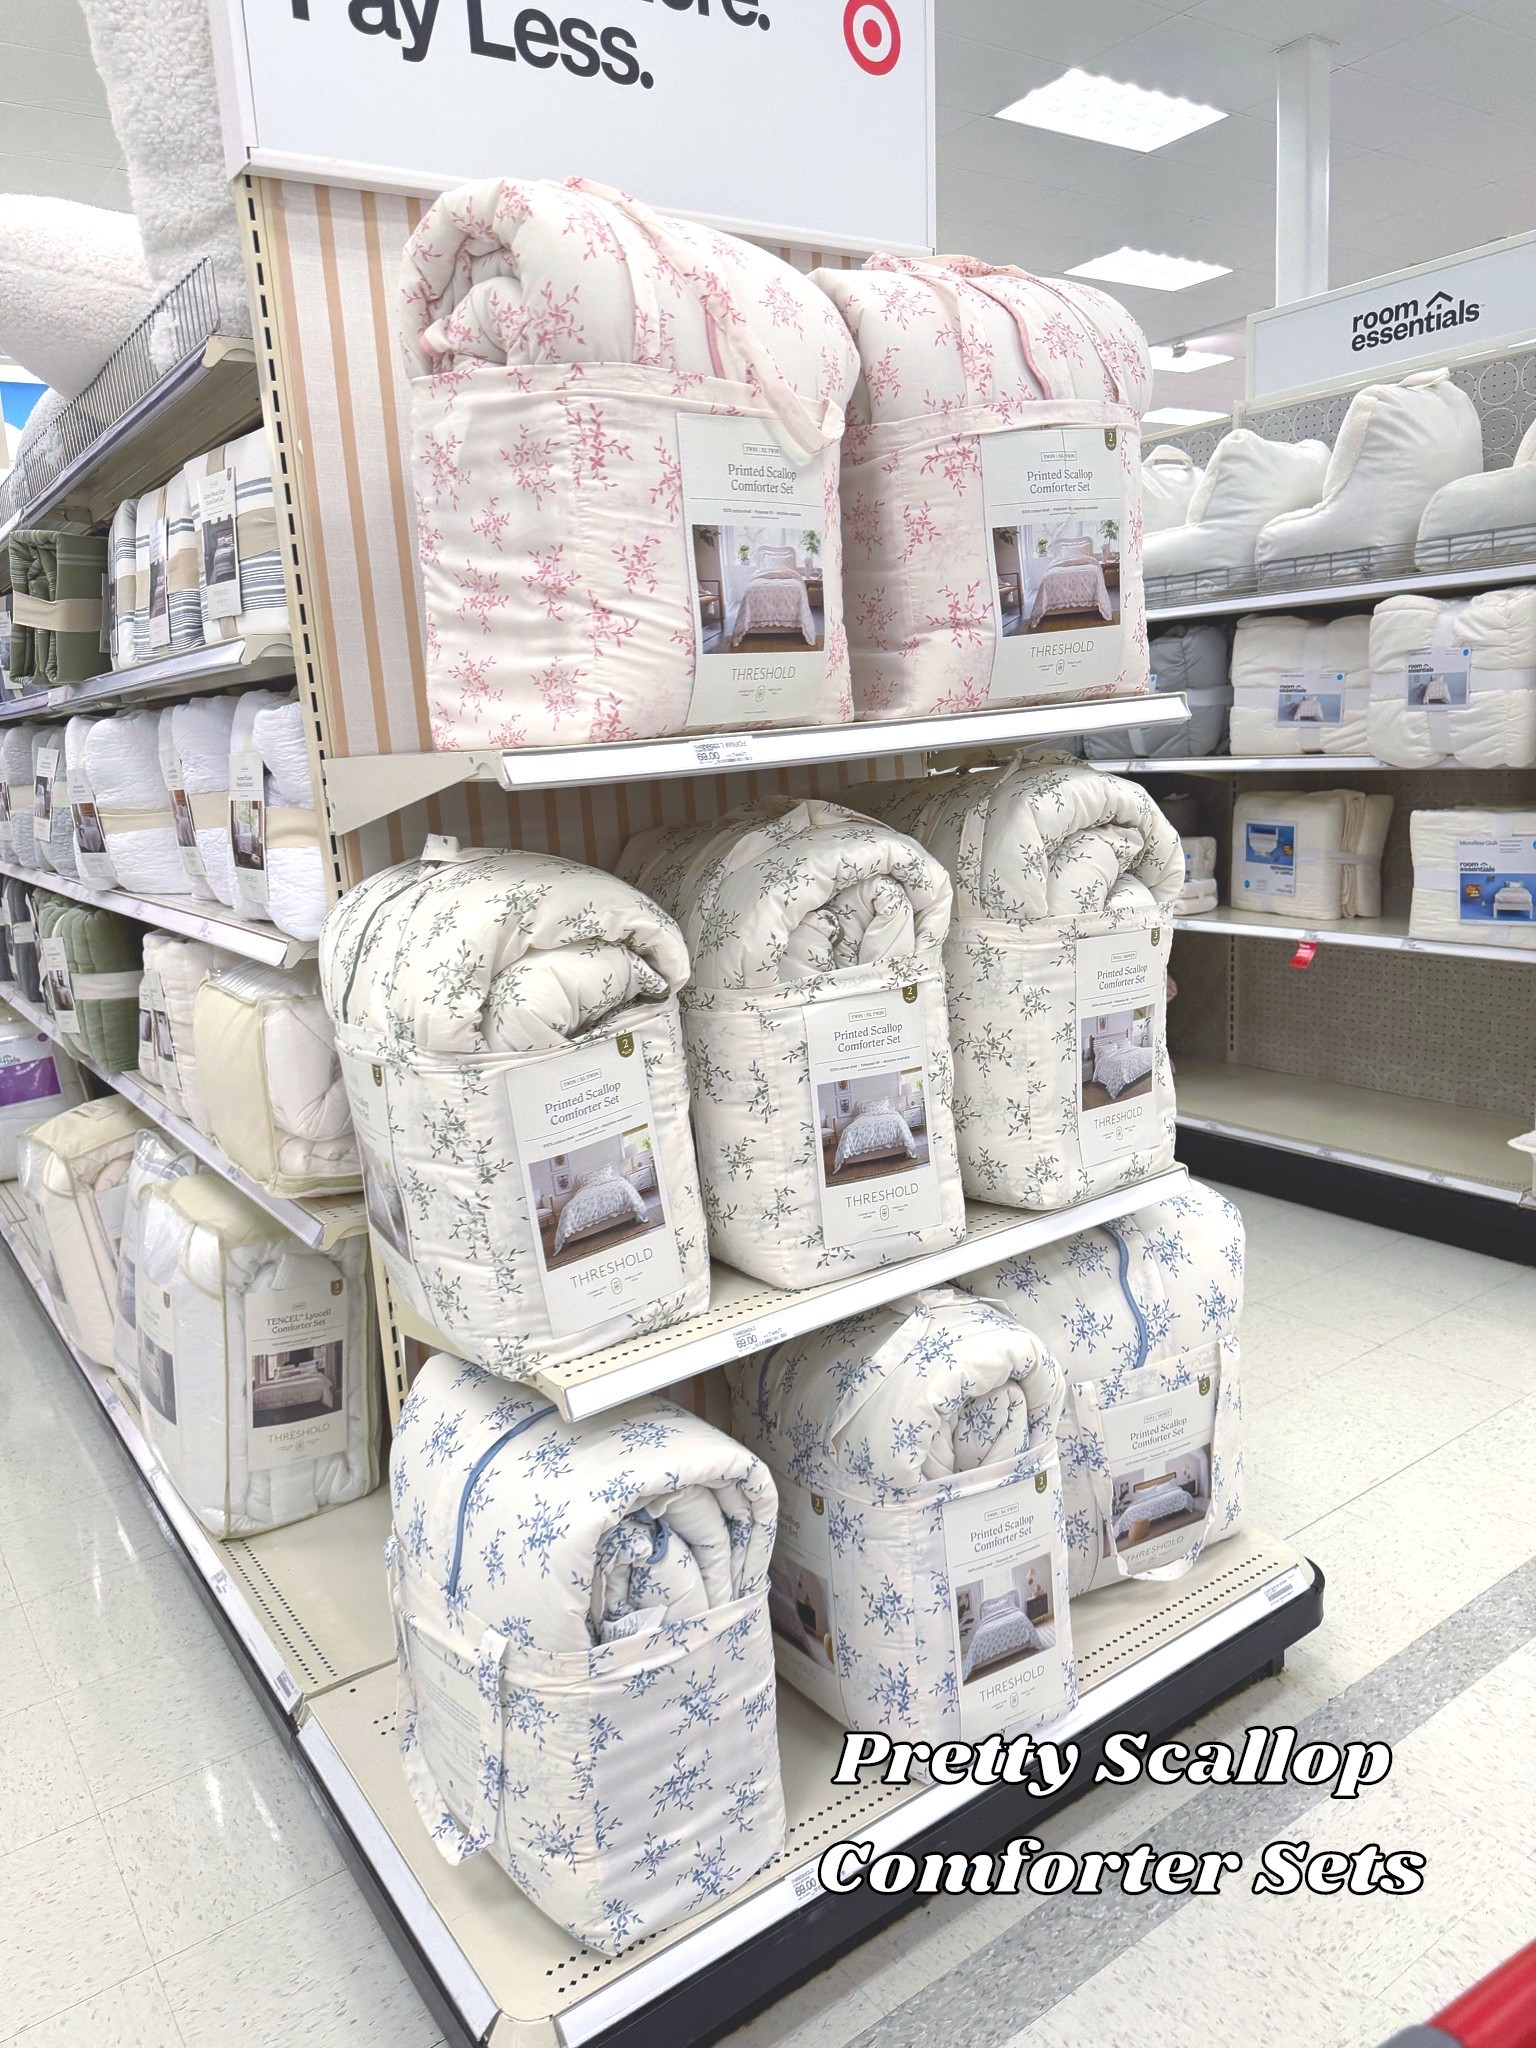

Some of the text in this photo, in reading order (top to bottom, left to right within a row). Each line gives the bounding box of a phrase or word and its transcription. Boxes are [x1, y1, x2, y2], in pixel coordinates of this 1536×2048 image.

[292, 0, 440, 62] ay
[467, 0, 654, 89] Less.
[1353, 299, 1419, 333] room
[1351, 299, 1480, 352] essentials
[728, 464, 797, 482] Printed Scallop
[1027, 469, 1093, 481] Printed Scallop
[731, 479, 794, 494] Comforter Set
[1030, 482, 1090, 494] Comforter Set
[1030, 640, 1094, 658] THRESHOLD
[731, 666, 796, 681] THRESHOLD
[697, 751, 720, 761] 69.00
[1097, 964, 1148, 980] Printed Scallop
[908, 987, 913, 995] 2
[1099, 975, 1145, 990] Comforter Set
[834, 1023, 902, 1041] Printed Scallop
[622, 1039, 629, 1049] 2
[837, 1035, 901, 1052] Comforter Set
[544, 1081, 621, 1115] Printed Scallop
[550, 1095, 620, 1125] Comforter Set
[1094, 1106, 1143, 1129] THRESHOLD
[845, 1182, 919, 1208] THRESHOLD
[569, 1247, 654, 1289] THRESHOLD
[305, 1308, 331, 1321] Lyocell
[271, 1319, 326, 1334] Comforter Set
[735, 1334, 758, 1349] 69.00
[268, 1422, 330, 1443] THRESHOLD
[1130, 1417, 1187, 1441] Printed Scallop
[1132, 1428, 1184, 1450] Comforter Set
[970, 1514, 1034, 1543] Printed Scallop
[974, 1526, 1032, 1553] Comforter Set
[1127, 1535, 1184, 1562] THRESHOLD
[979, 1665, 1045, 1702] THRESHOLD
[795, 1878, 817, 1897] 69.00
